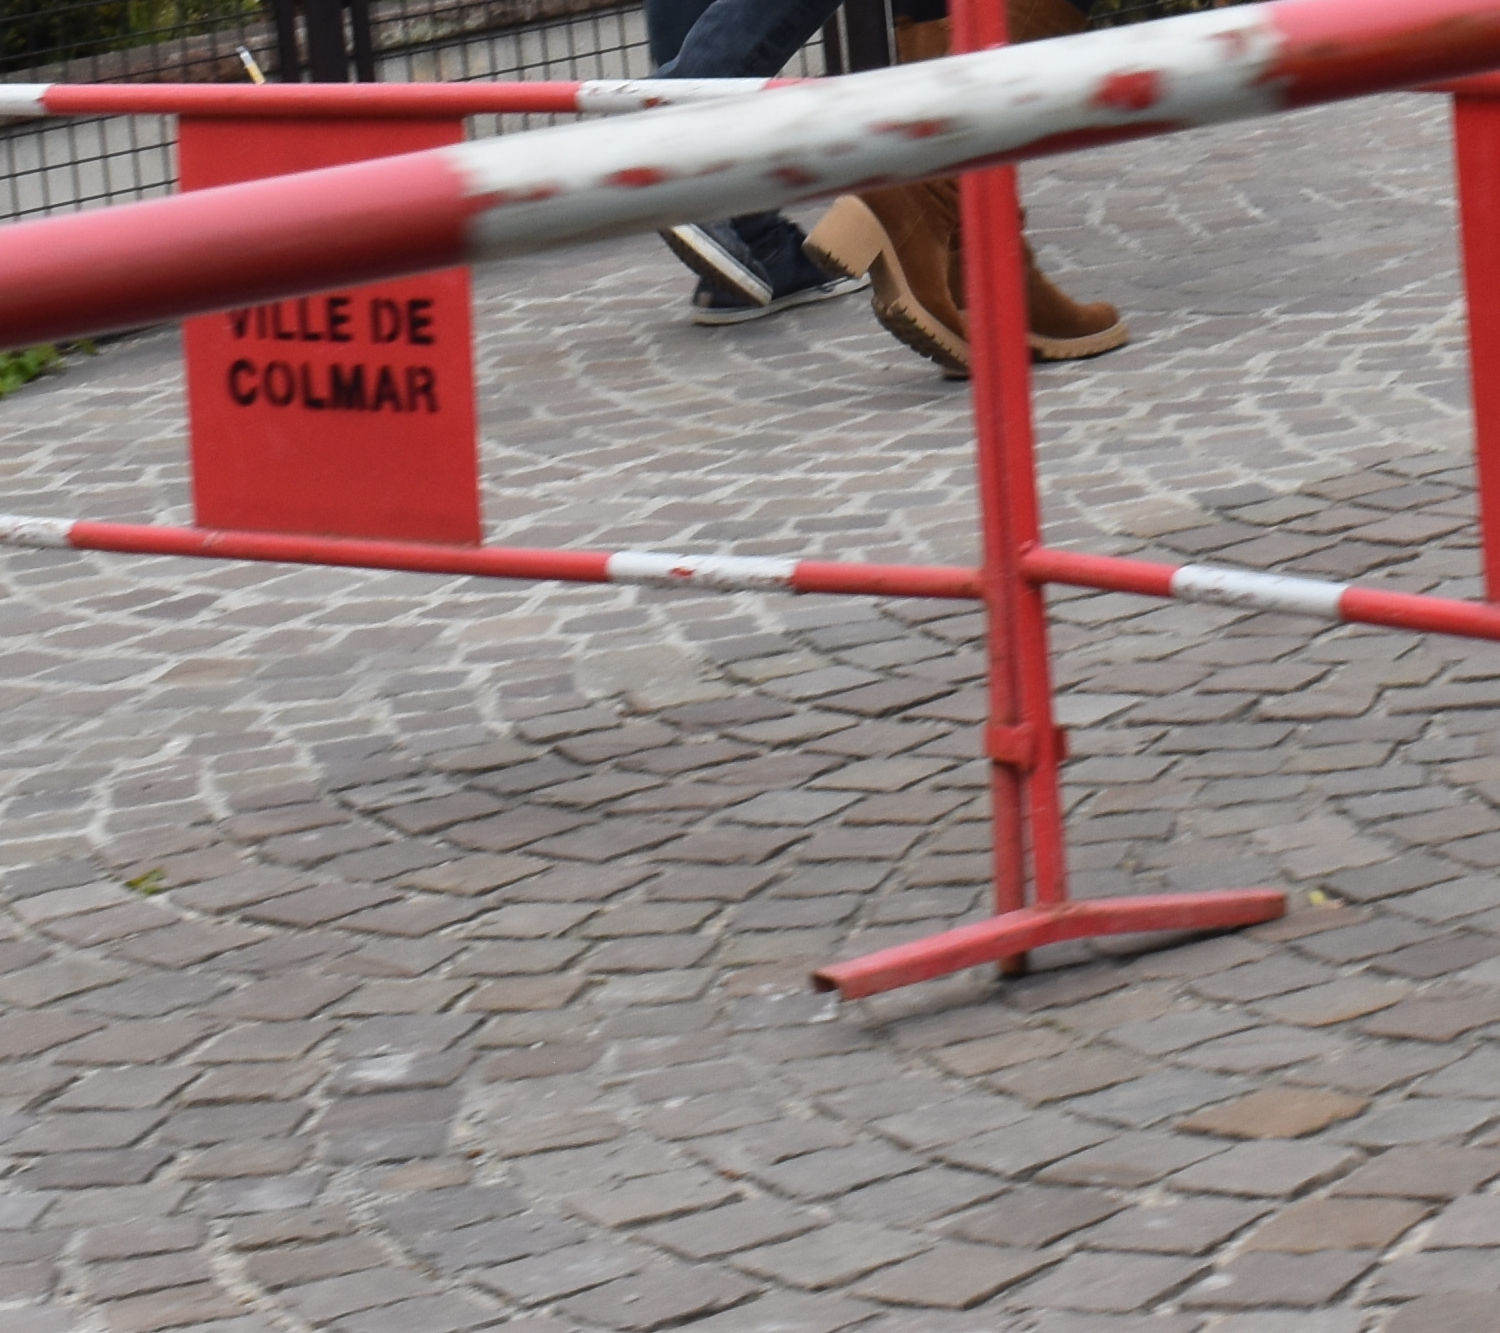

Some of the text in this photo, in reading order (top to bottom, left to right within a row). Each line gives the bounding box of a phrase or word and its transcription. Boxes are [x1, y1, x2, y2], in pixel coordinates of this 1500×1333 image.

[229, 296, 434, 345] VILLE DE
[227, 358, 438, 413] COLMAR
